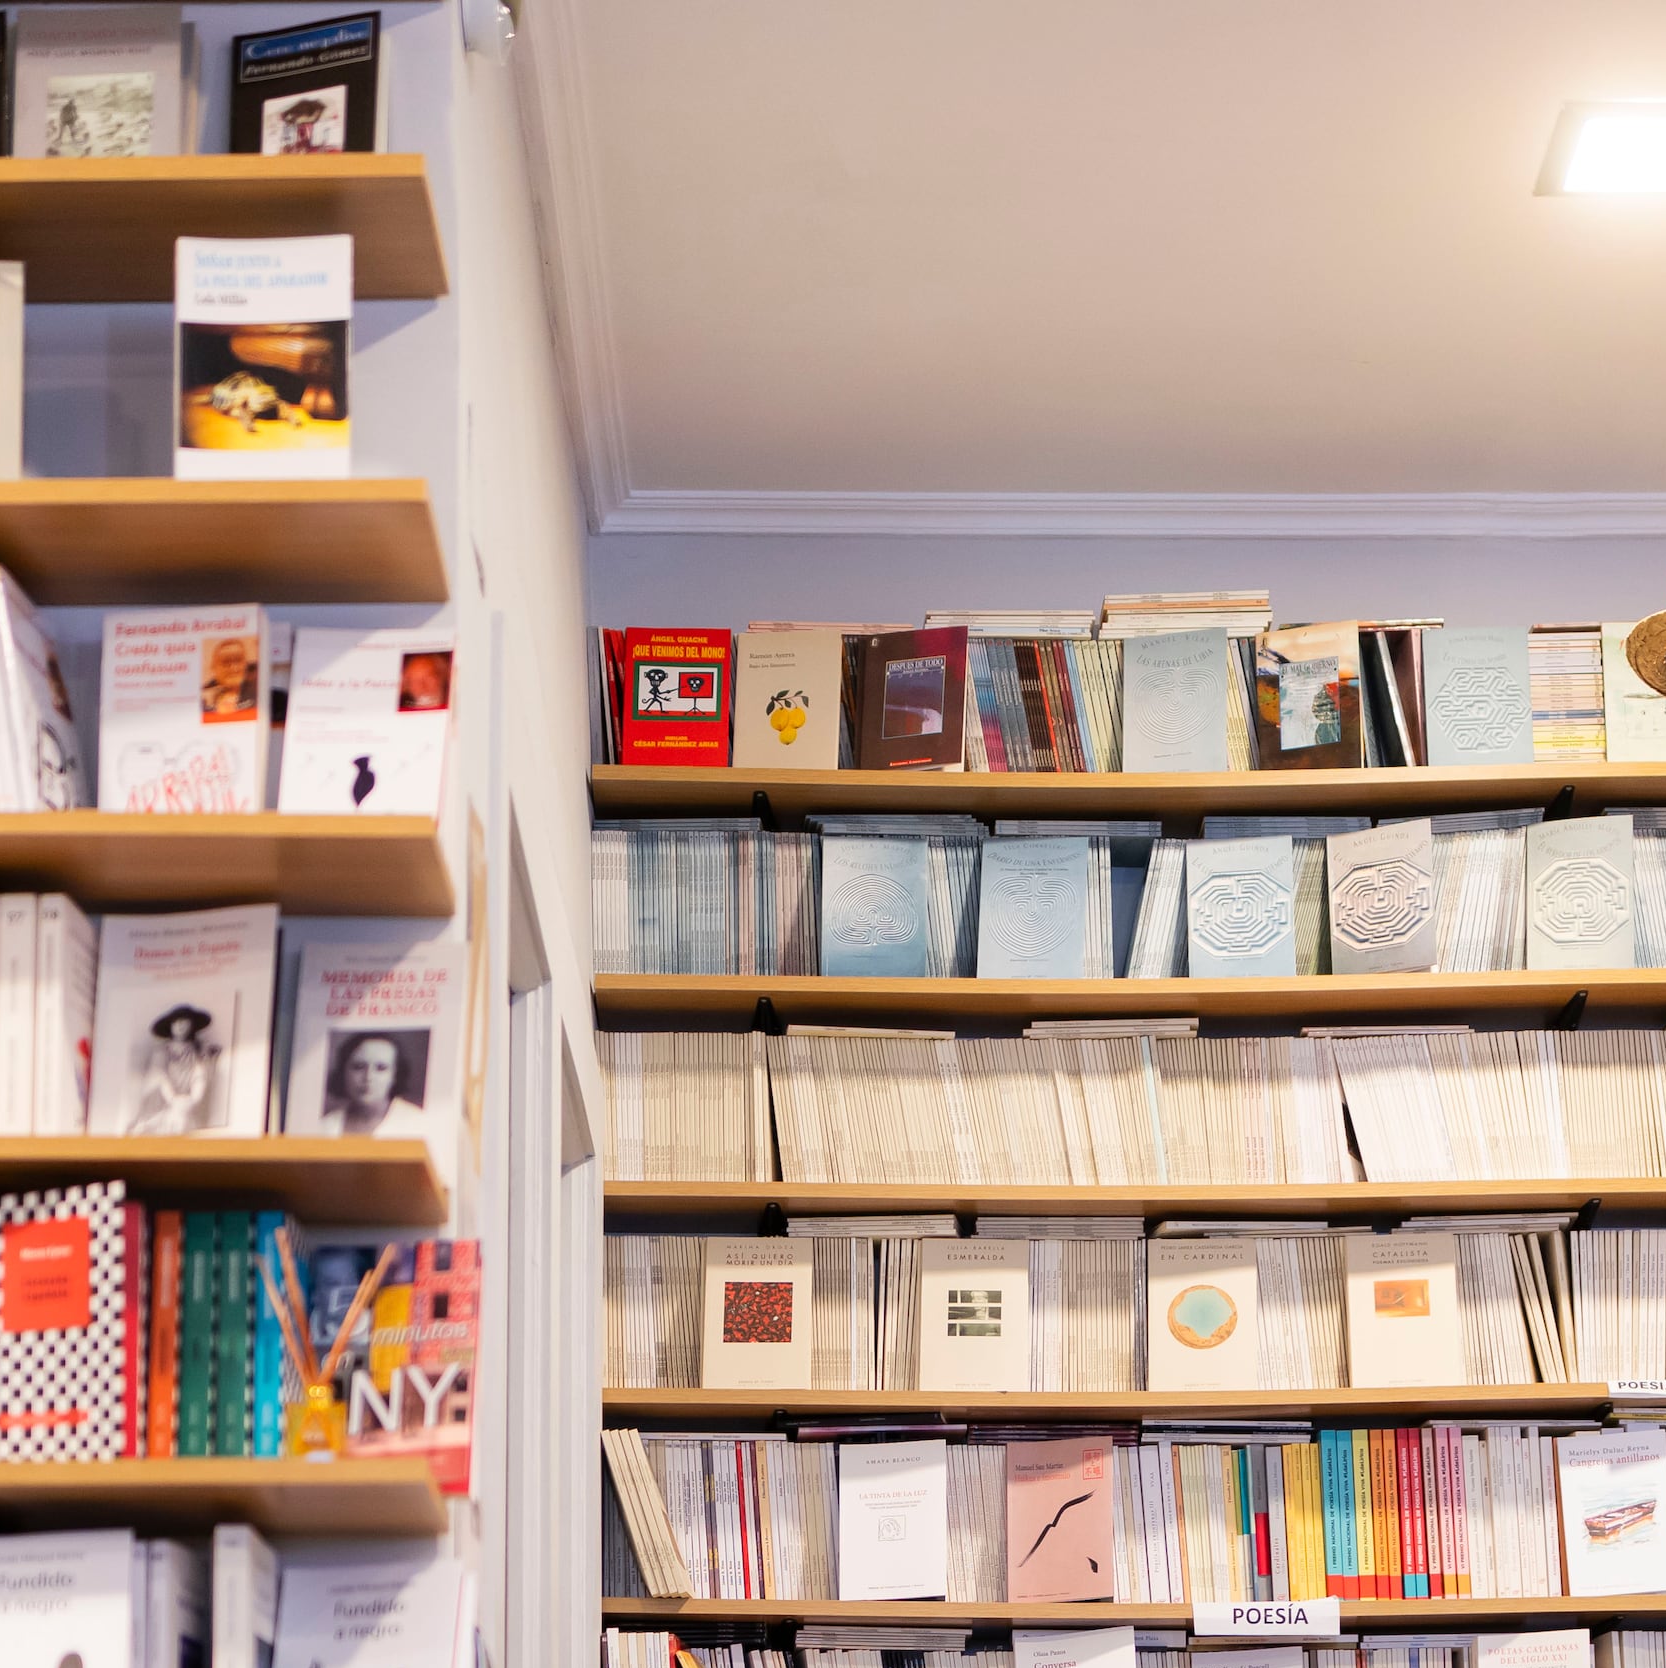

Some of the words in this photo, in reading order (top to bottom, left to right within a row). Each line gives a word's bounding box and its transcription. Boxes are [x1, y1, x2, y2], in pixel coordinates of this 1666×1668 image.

[114, 619, 187, 636] Fernando
[192, 618, 246, 634] Arrabal
[632, 645, 650, 659] ¡QUE
[651, 645, 684, 659] VENIMOS
[685, 645, 700, 659] DEL
[700, 645, 725, 660] MONO!
[423, 969, 447, 983] DE
[325, 1005, 349, 1016] DE
[946, 1253, 1005, 1262] ESMERALDA
[1183, 1253, 1244, 1261] CARDINAL
[1372, 1250, 1428, 1259] CATALISTA
[372, 1320, 470, 1346] minutos
[347, 1362, 461, 1436] NY
[1568, 1456, 1614, 1469] Cangrejos
[1615, 1453, 1661, 1465] antillanos
[333, 1598, 404, 1617] Fundido
[1232, 1603, 1309, 1625] POESÍA
[347, 1625, 398, 1642] negro
[1499, 1655, 1519, 1666] DEL
[1520, 1654, 1547, 1665] SIGLO
[1549, 1653, 1568, 1664] XXI
